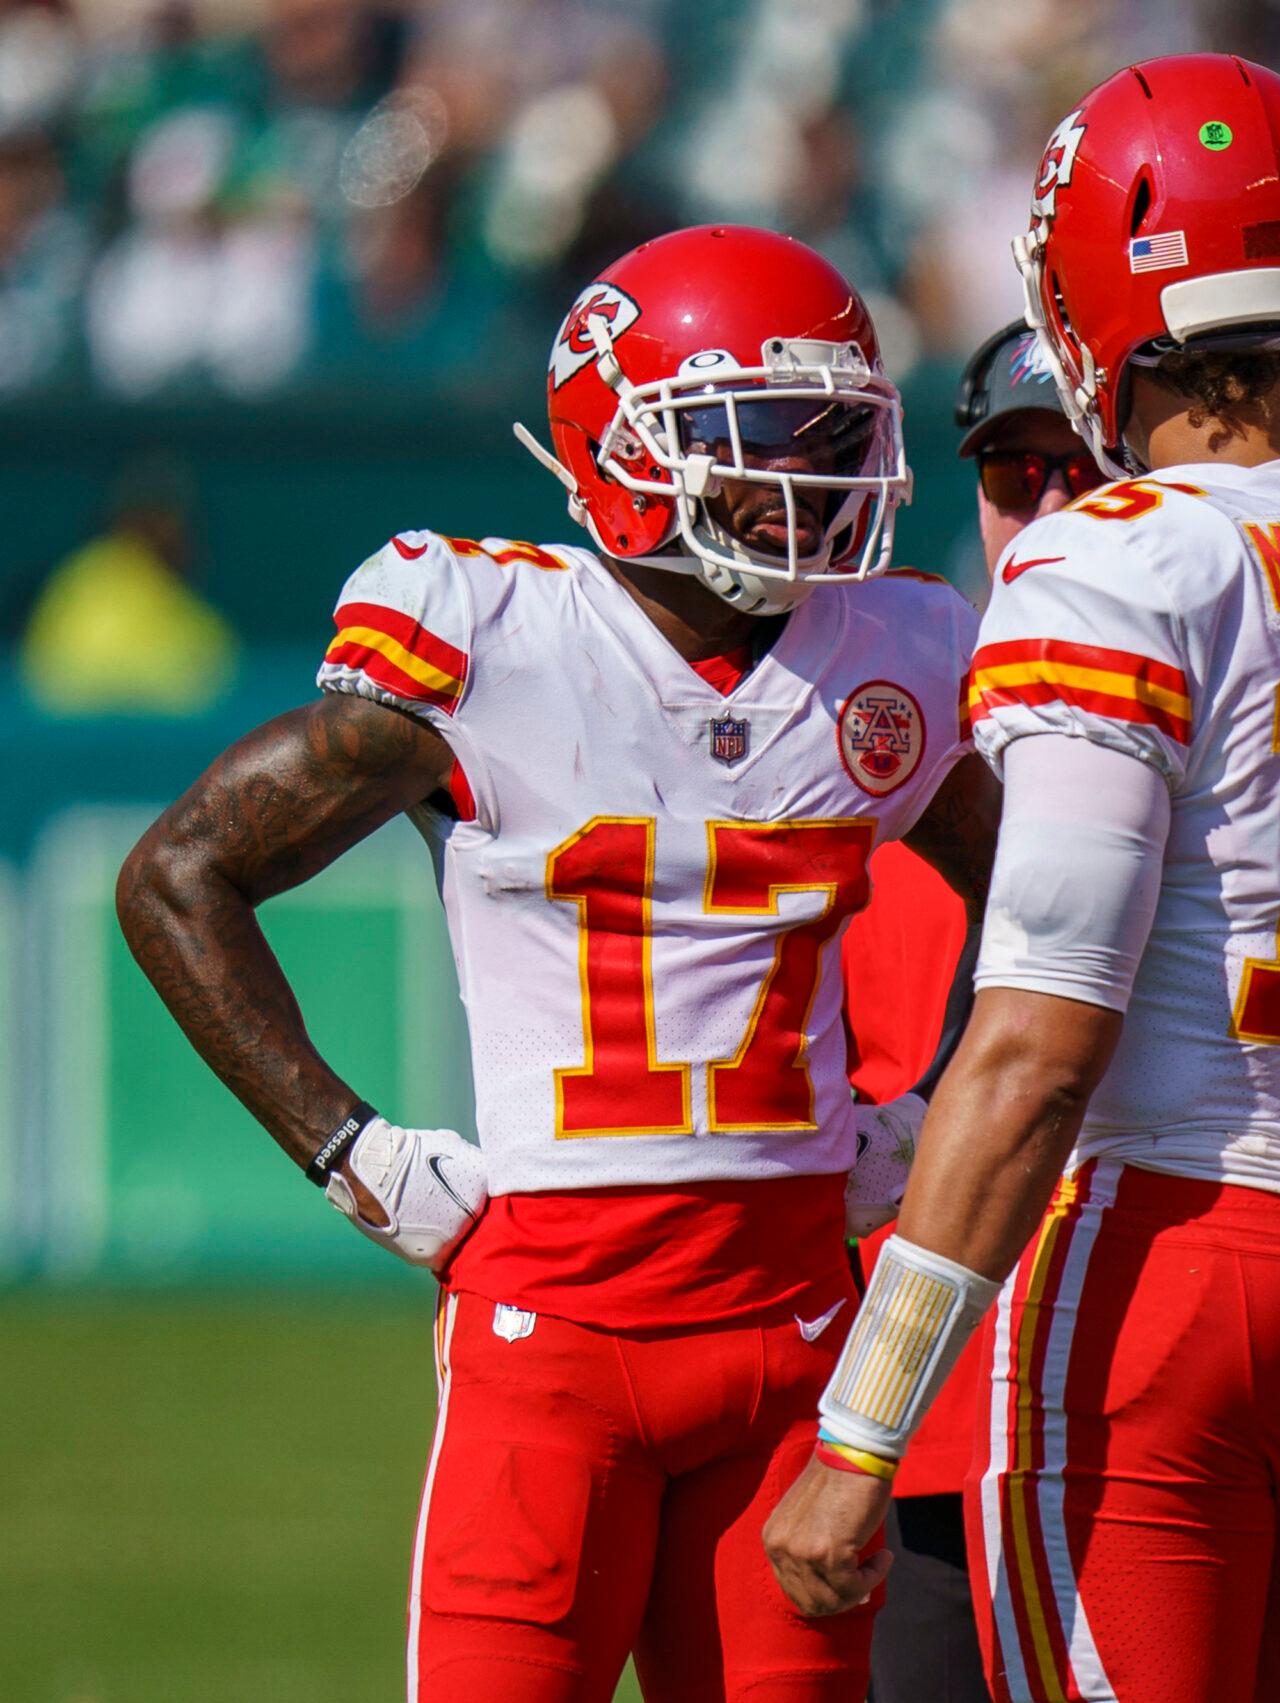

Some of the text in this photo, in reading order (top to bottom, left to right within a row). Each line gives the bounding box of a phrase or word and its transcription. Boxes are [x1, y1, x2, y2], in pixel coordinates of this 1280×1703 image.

[715, 735, 744, 756] NFL
[544, 815, 880, 1140] 17
[314, 1117, 361, 1170] Blessed
